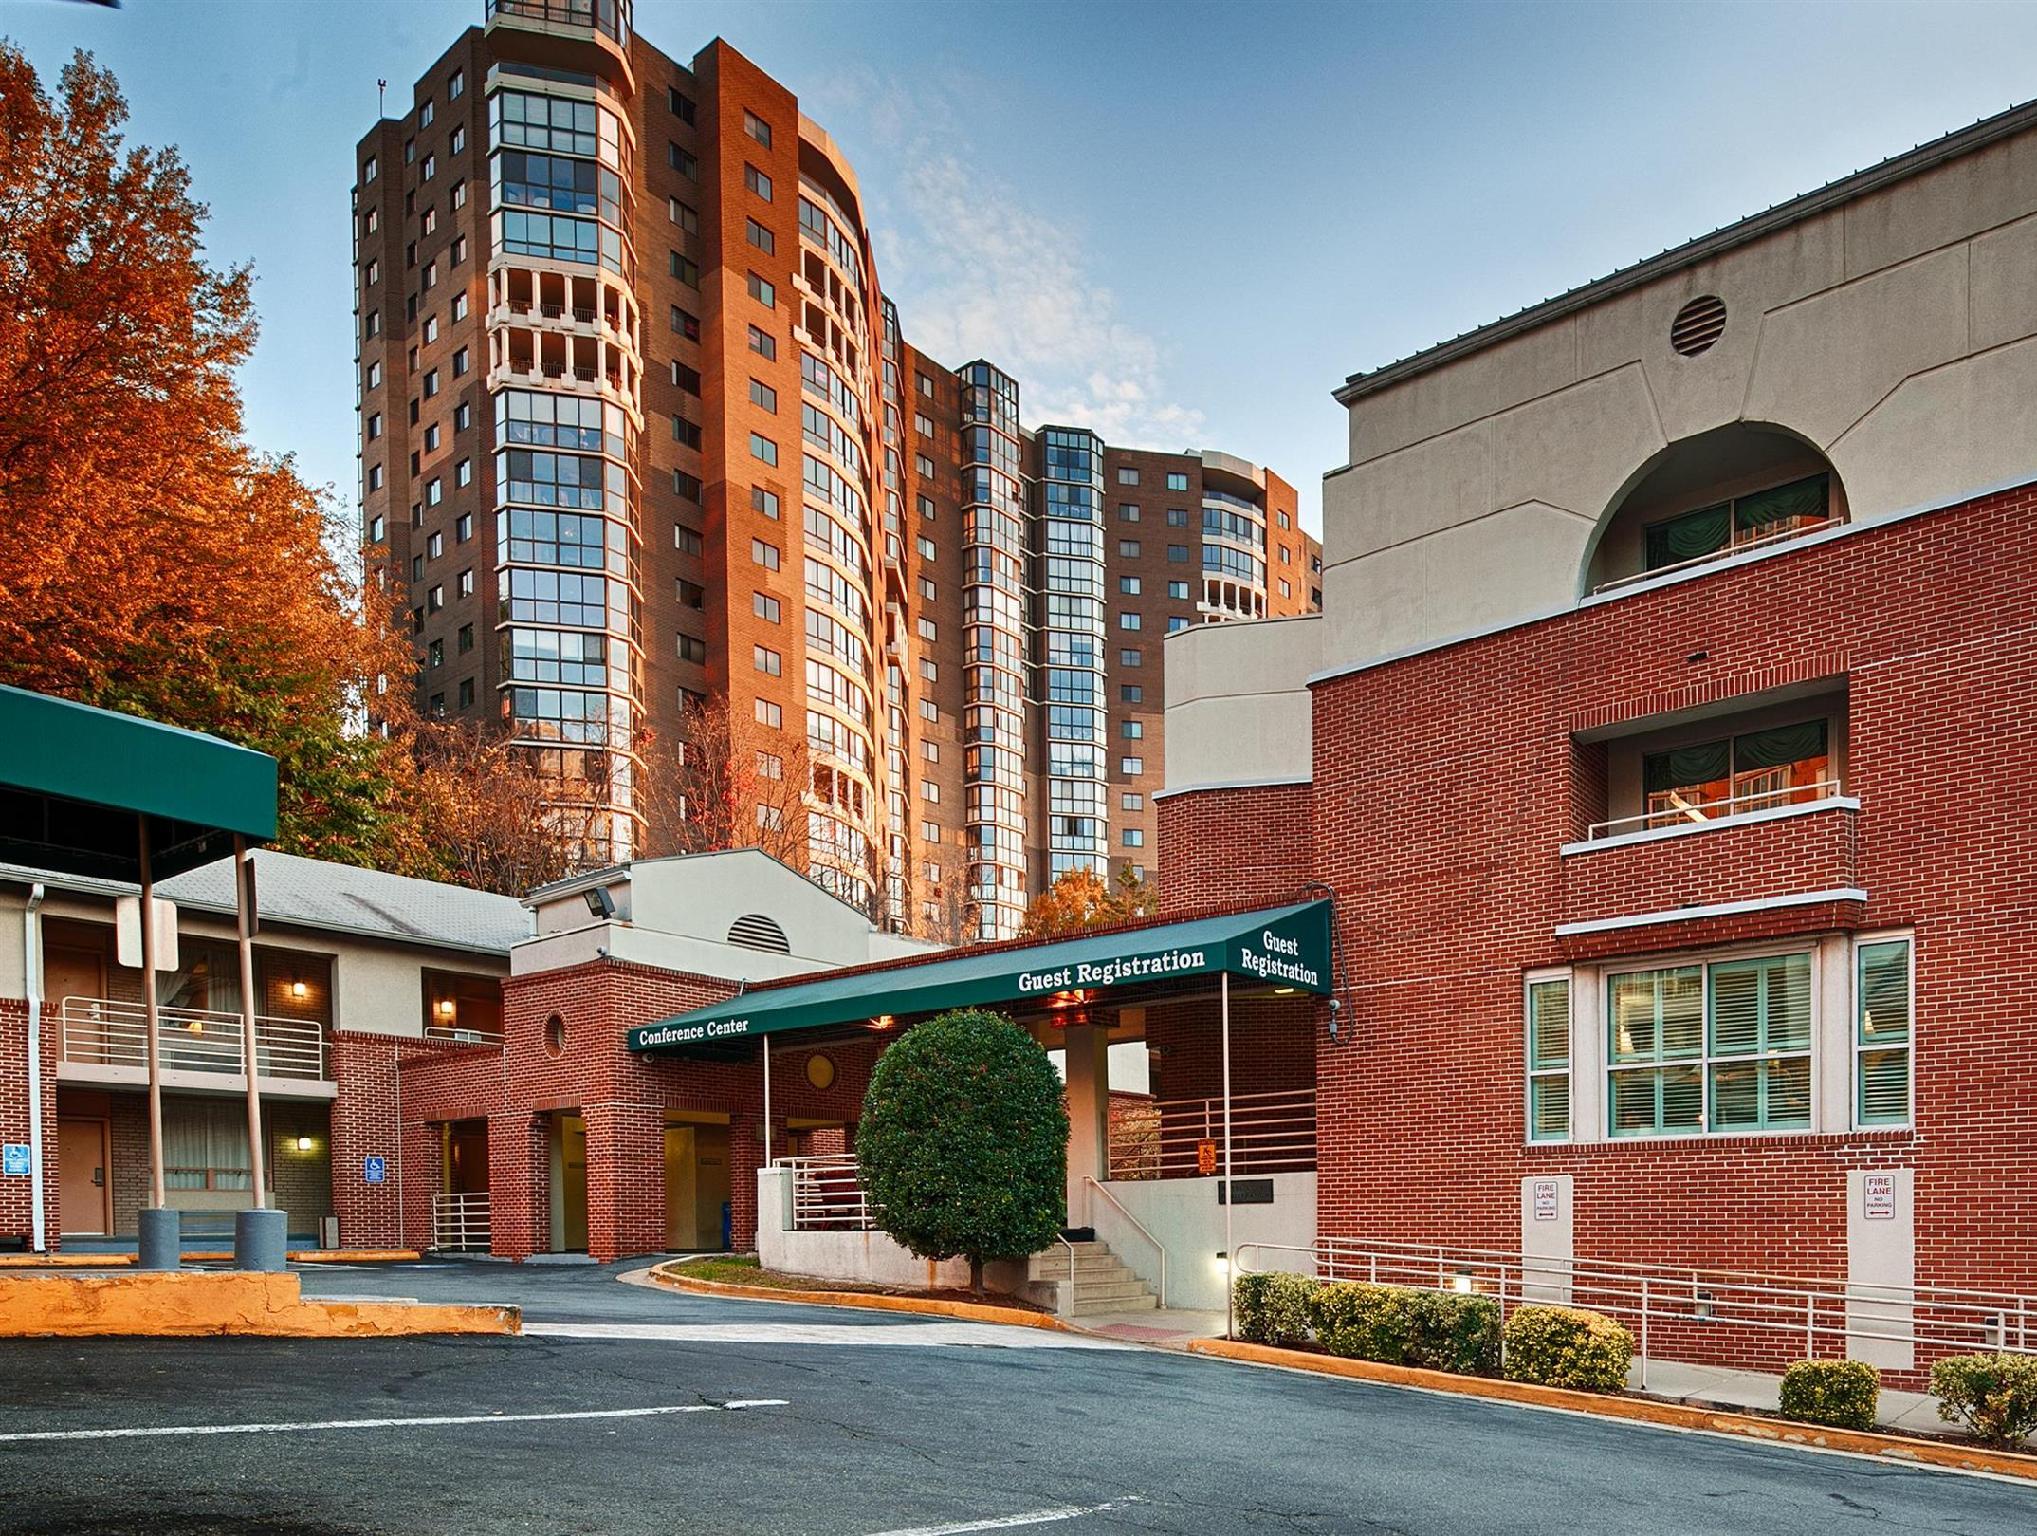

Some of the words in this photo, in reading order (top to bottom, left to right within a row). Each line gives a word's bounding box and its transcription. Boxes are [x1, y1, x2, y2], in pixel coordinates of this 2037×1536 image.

[1263, 930, 1299, 956] Guest
[1018, 967, 1072, 992] Guest
[1076, 950, 1206, 985] Registration
[1241, 948, 1318, 986] Registration
[639, 1026, 704, 1046] Conference
[706, 1019, 749, 1036] Center
[1537, 1184, 1555, 1192] FIRE
[1868, 1177, 1890, 1186] FIRE
[1536, 1192, 1556, 1200] LANE
[1866, 1187, 1892, 1195] LANE
